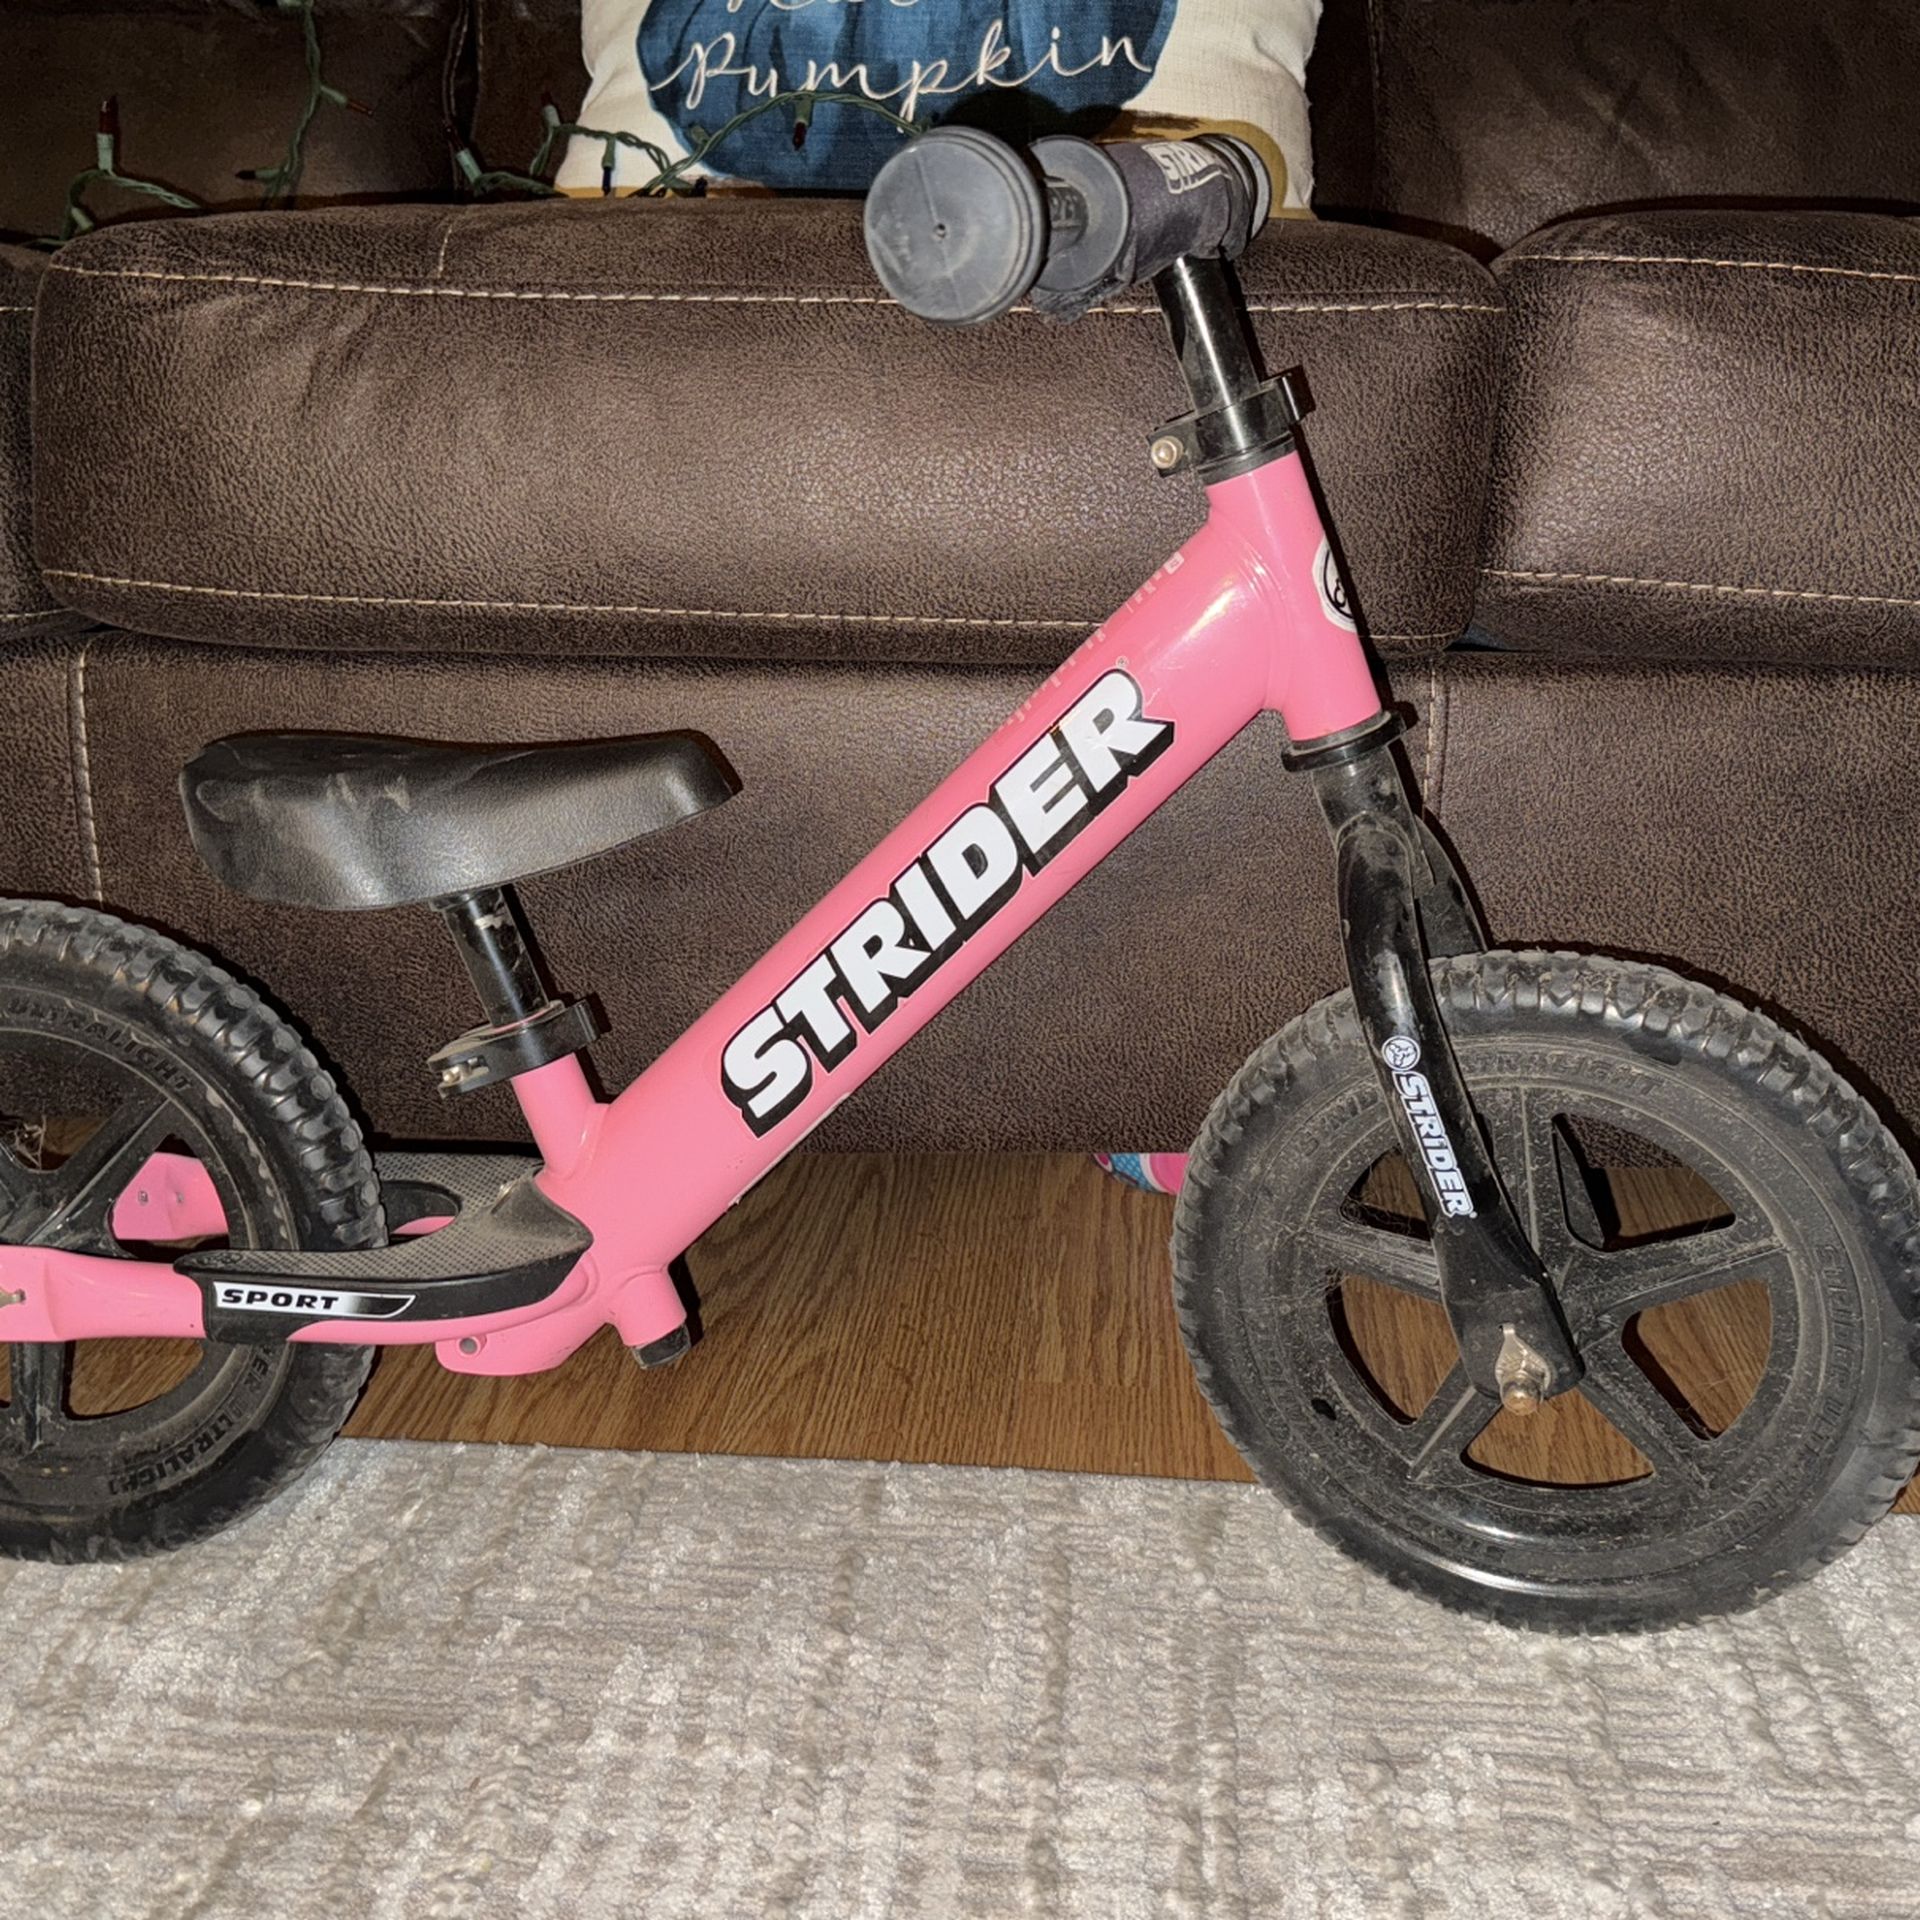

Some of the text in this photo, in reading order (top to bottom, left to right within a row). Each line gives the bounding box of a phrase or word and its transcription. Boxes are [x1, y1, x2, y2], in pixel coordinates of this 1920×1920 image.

[650, 18, 1152, 130] pumpkin
[722, 668, 1175, 1138] STRIDER
[1394, 1073, 1474, 1216] STRIDER
[222, 1289, 339, 1310] SPORT
